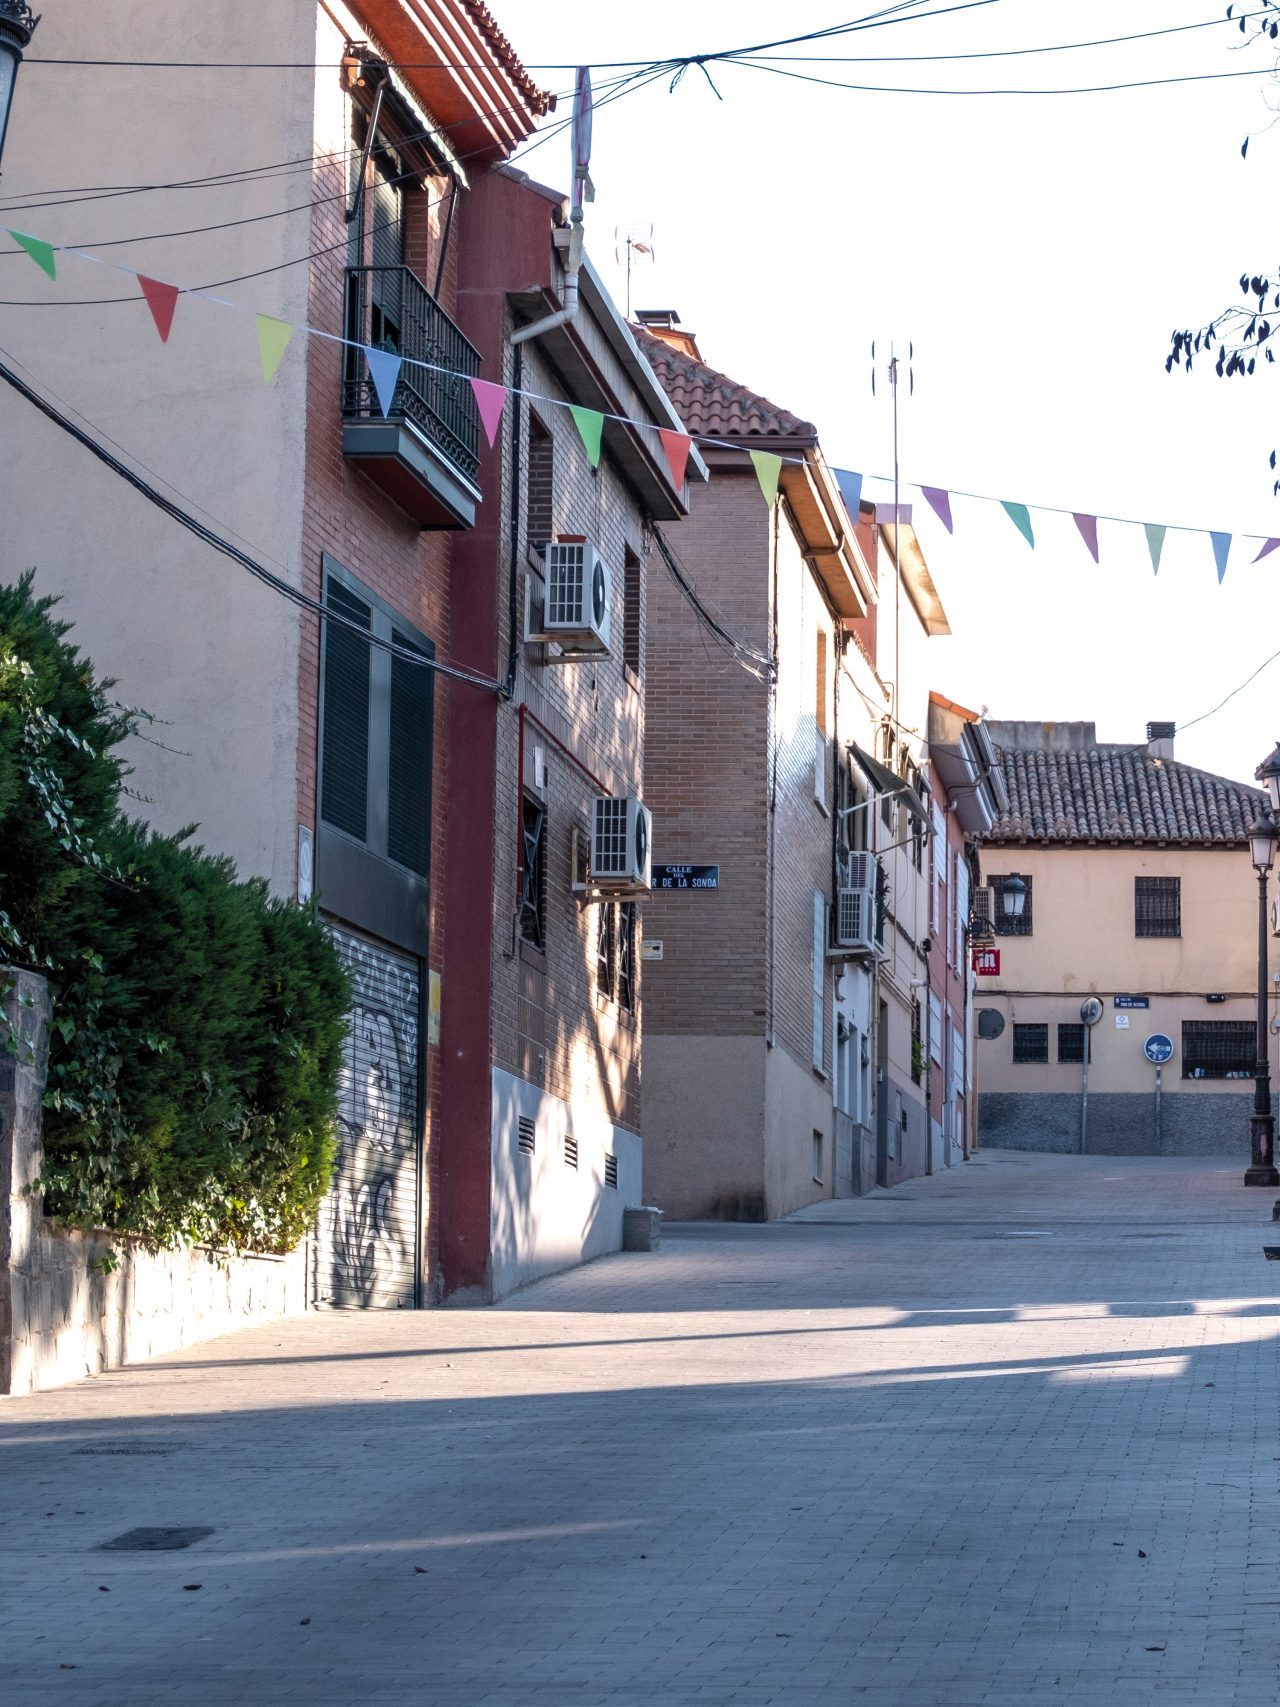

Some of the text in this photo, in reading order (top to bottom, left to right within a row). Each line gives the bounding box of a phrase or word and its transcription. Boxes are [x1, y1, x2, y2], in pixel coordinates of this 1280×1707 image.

[662, 878, 673, 888] DE
[678, 878, 688, 888] LA
[692, 878, 717, 888] SONDA
